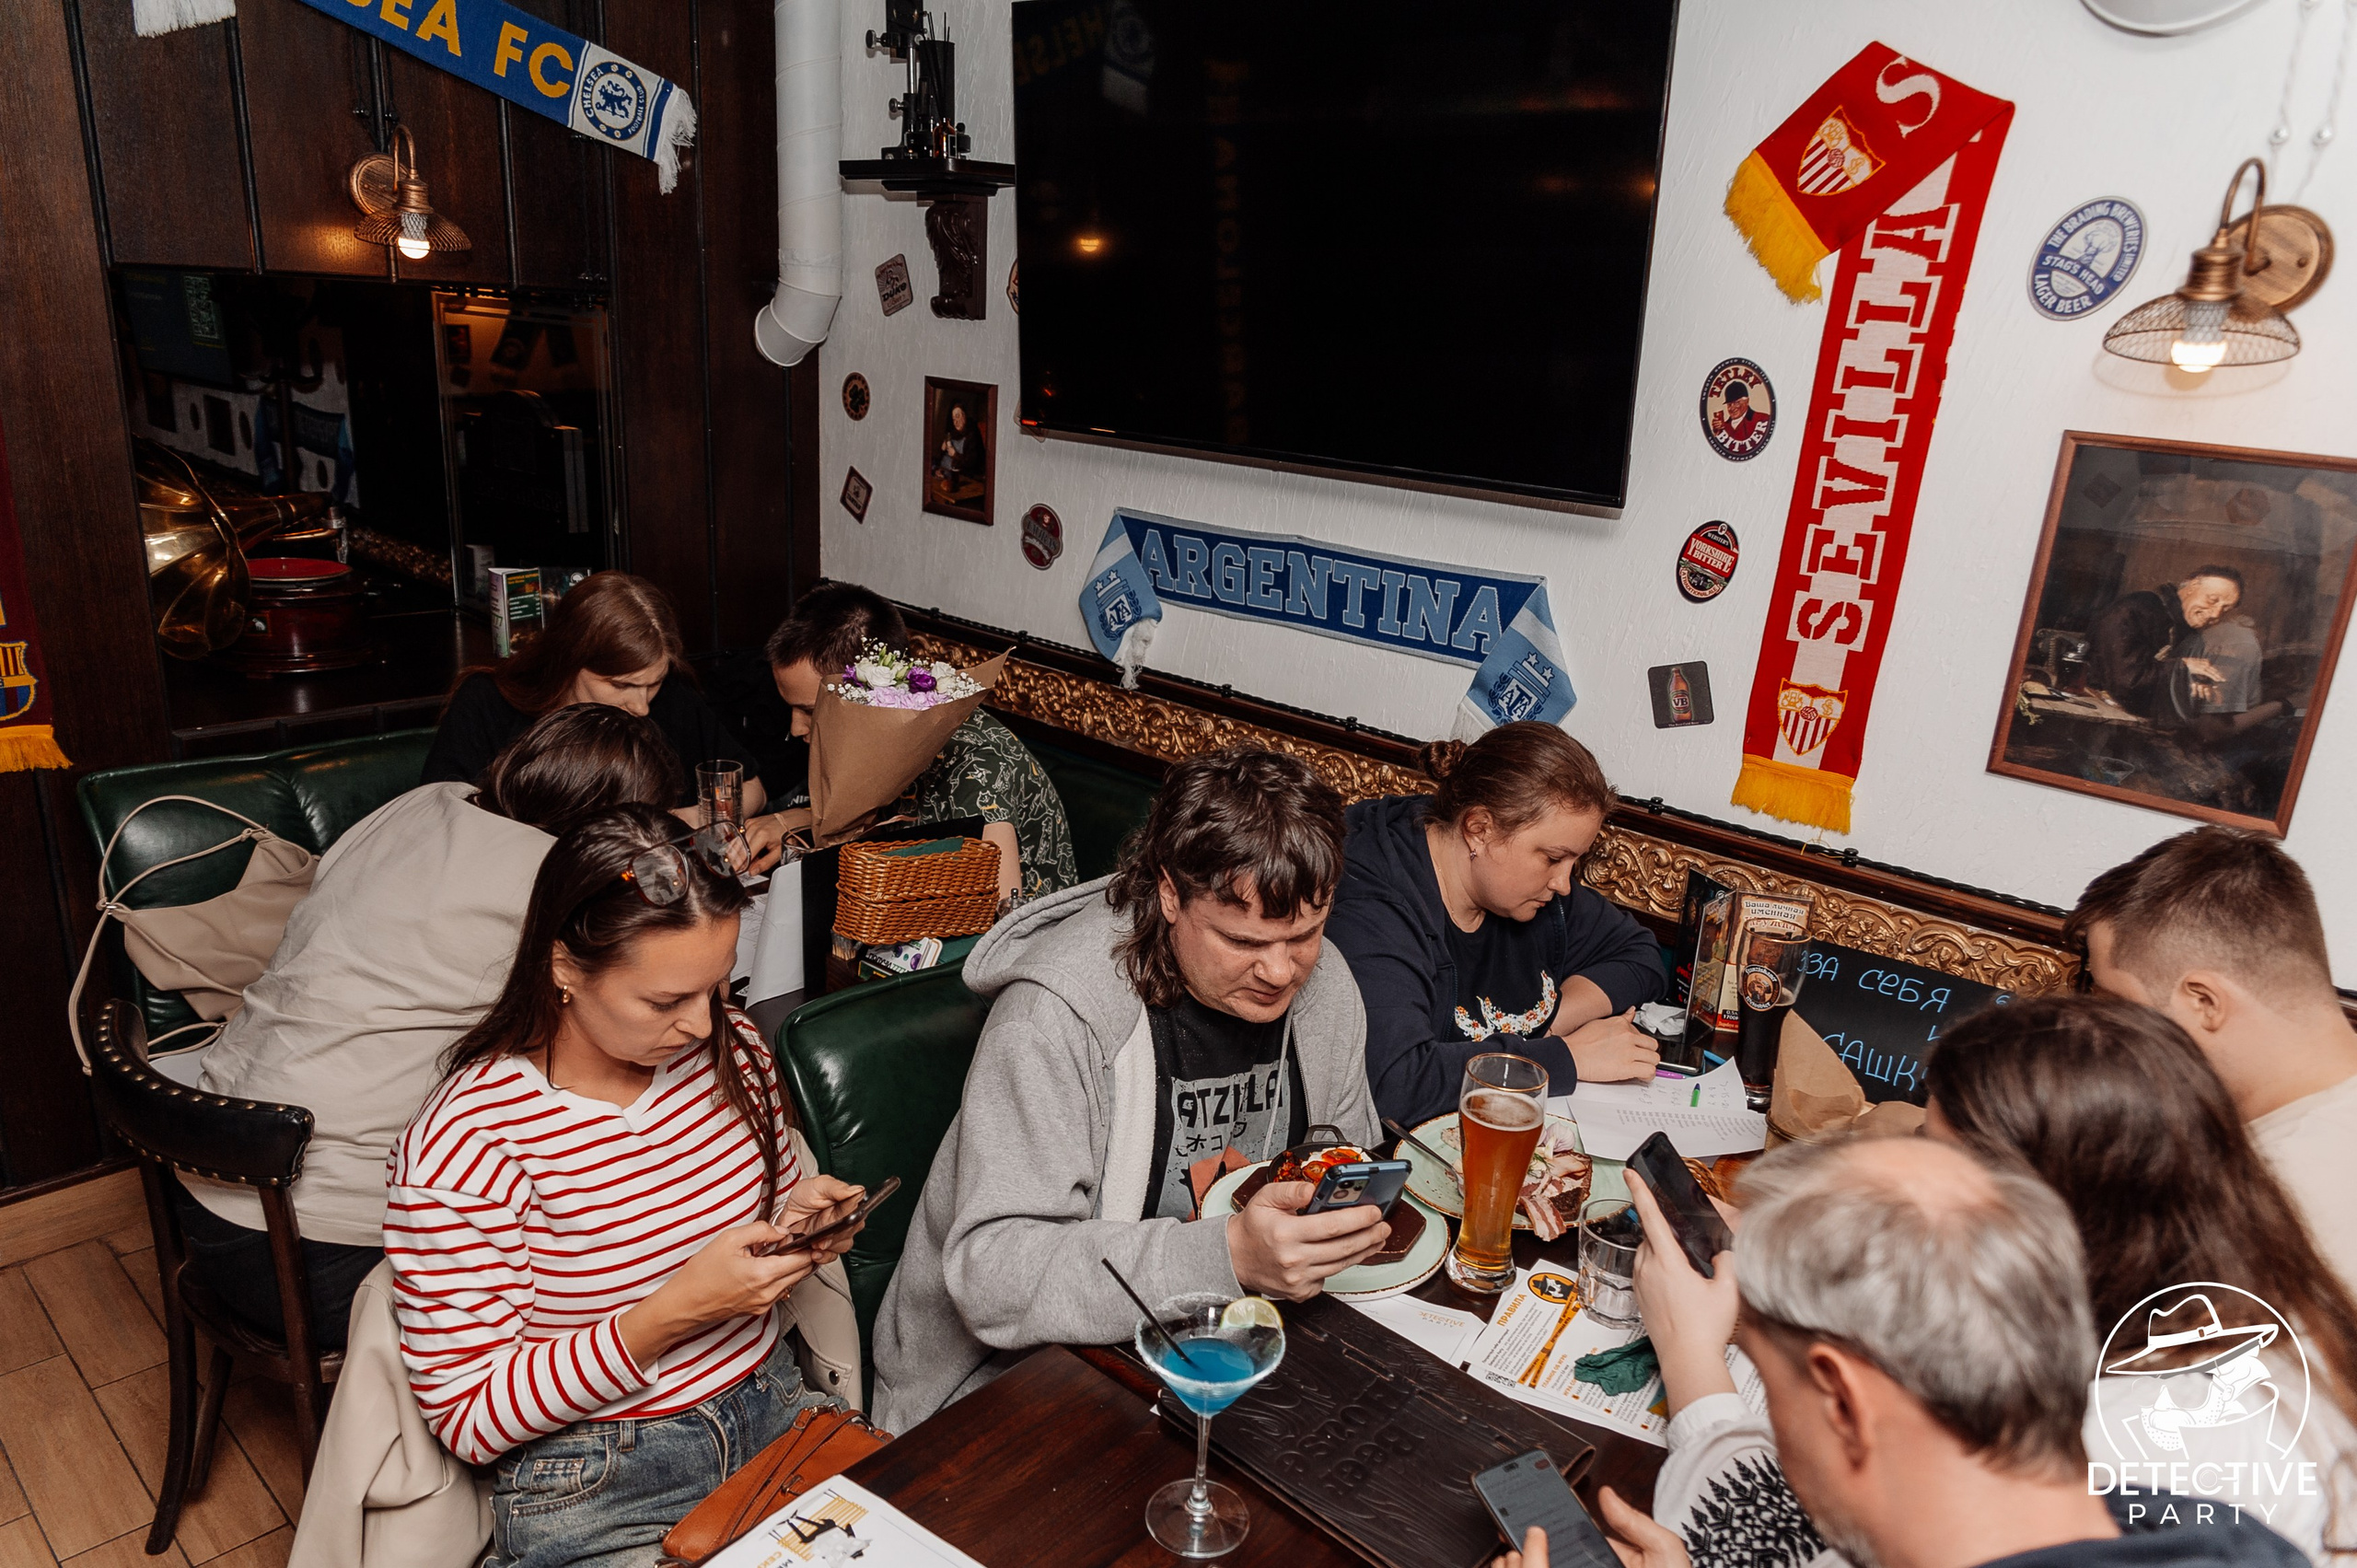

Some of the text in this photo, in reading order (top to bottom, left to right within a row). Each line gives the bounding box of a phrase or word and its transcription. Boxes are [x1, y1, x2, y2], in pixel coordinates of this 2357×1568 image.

[493, 20, 575, 98] FC
[583, 67, 604, 118] CHELSEA
[2047, 228, 2069, 249] THE
[2061, 202, 2111, 234] BRADING
[2109, 203, 2141, 253] BREWERIES
[2034, 273, 2094, 313] LAGER BEER
[2042, 255, 2106, 295] STAG'S HEAD
[1709, 366, 1762, 398] TETLEY
[1716, 420, 1768, 452] BITTER
[1786, 203, 1962, 652] SEVILLA
[1687, 537, 1735, 573] YORKSHIRE
[1692, 550, 1723, 569] BITTER
[1140, 528, 1504, 655] ARGENTINA
[1673, 698, 1689, 706] VB
[1496, 1293, 1527, 1327] ПРАВИЛА
